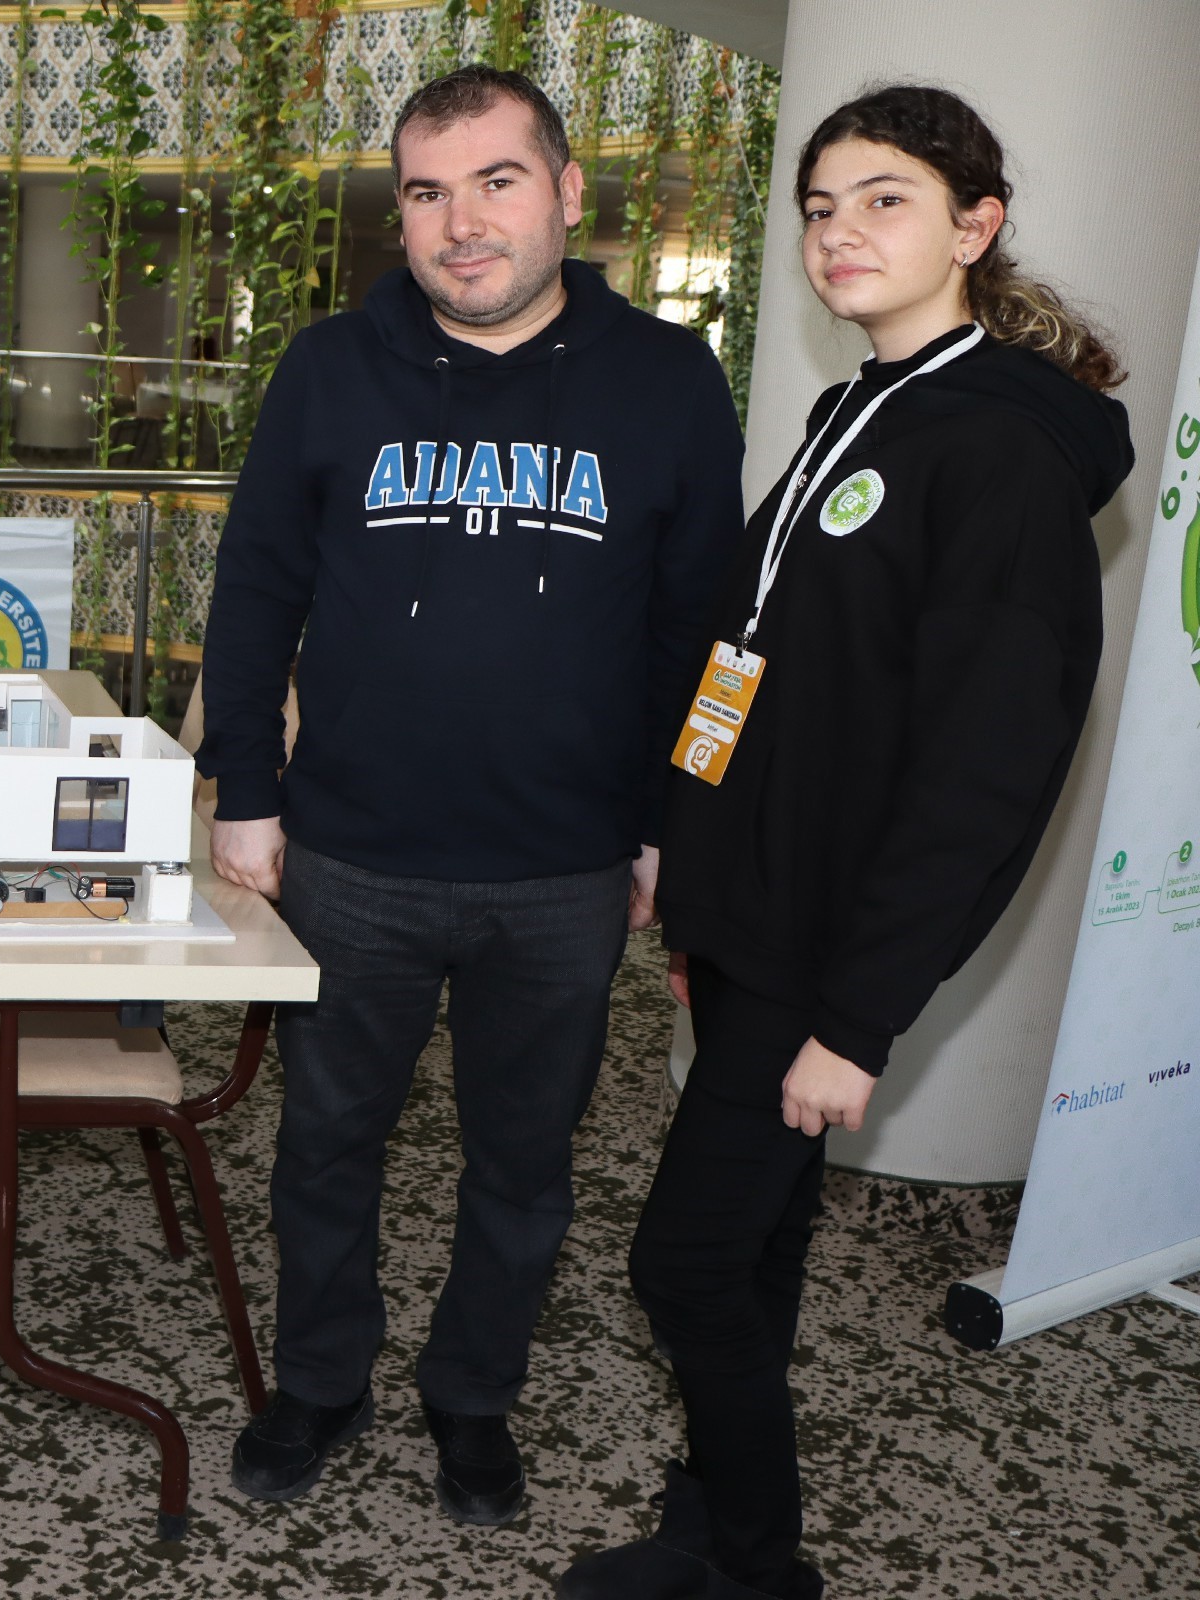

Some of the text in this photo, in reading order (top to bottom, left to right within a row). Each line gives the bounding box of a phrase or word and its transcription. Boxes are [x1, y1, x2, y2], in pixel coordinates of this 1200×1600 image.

[364, 441, 608, 524] ADANA
[466, 507, 499, 535] 01
[1115, 892, 1130, 900] Ekim
[1171, 888, 1186, 899] Ocak
[1124, 901, 1140, 911] 2023
[1068, 1080, 1126, 1113] habitat
